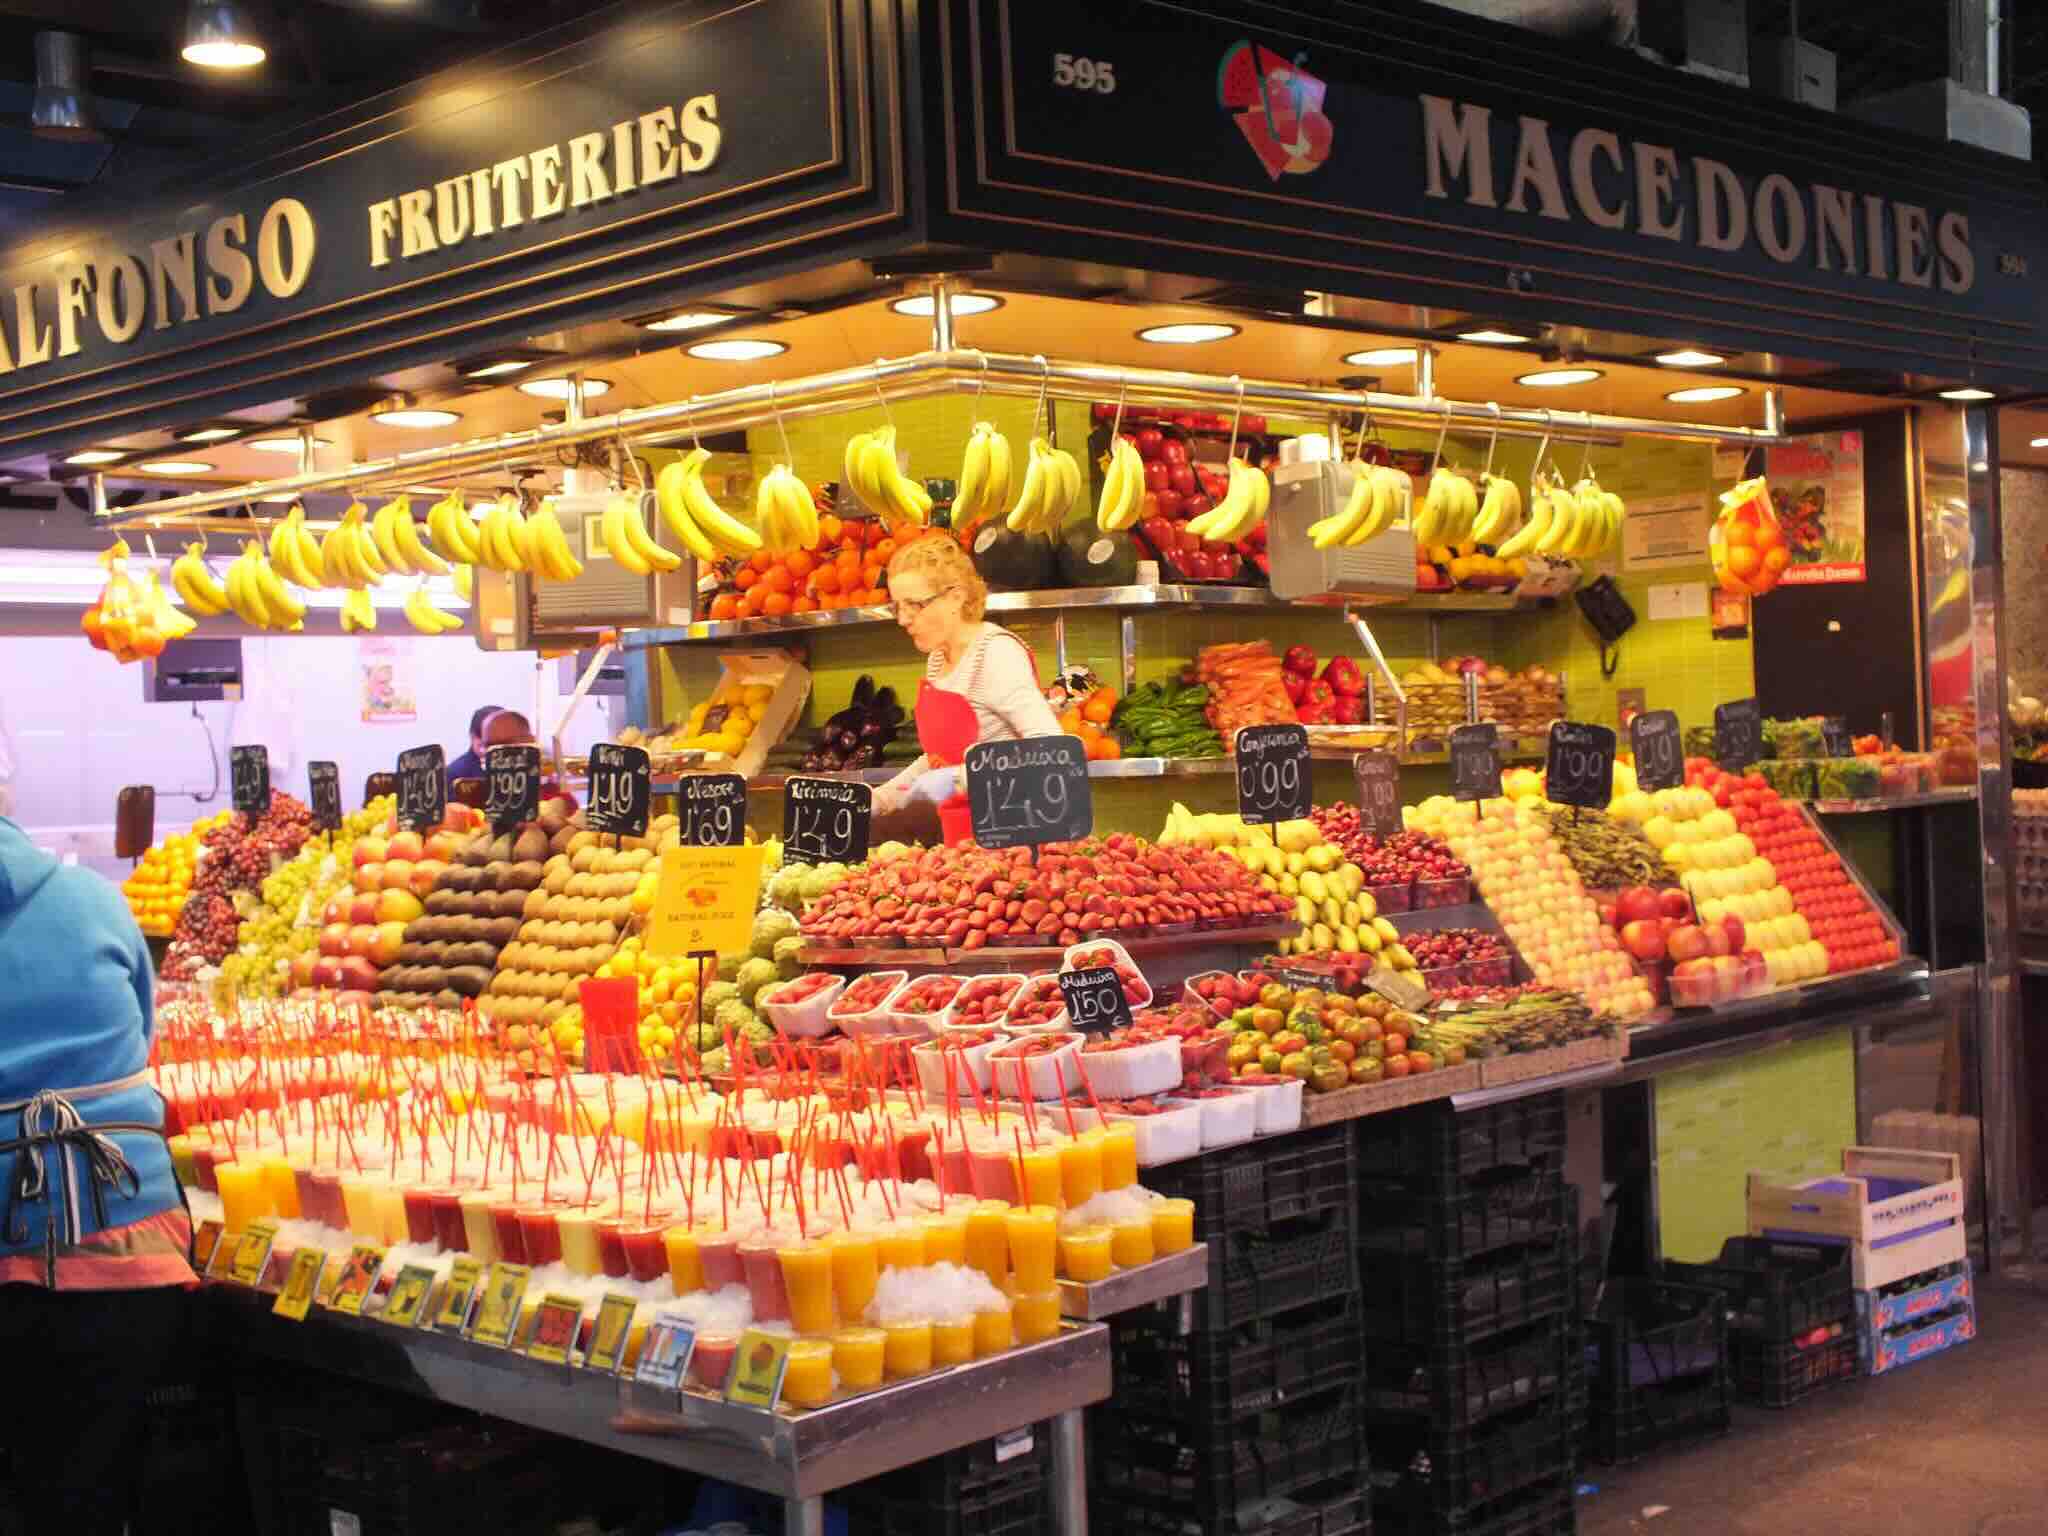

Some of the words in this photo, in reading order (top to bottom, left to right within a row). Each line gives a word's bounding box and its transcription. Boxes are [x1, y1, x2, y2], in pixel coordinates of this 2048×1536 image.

[1054, 53, 1116, 94] 595
[368, 94, 722, 268] FRUITERIES
[1419, 93, 1976, 295] MACEDONIES
[1071, 987, 1119, 1023] 1'50
